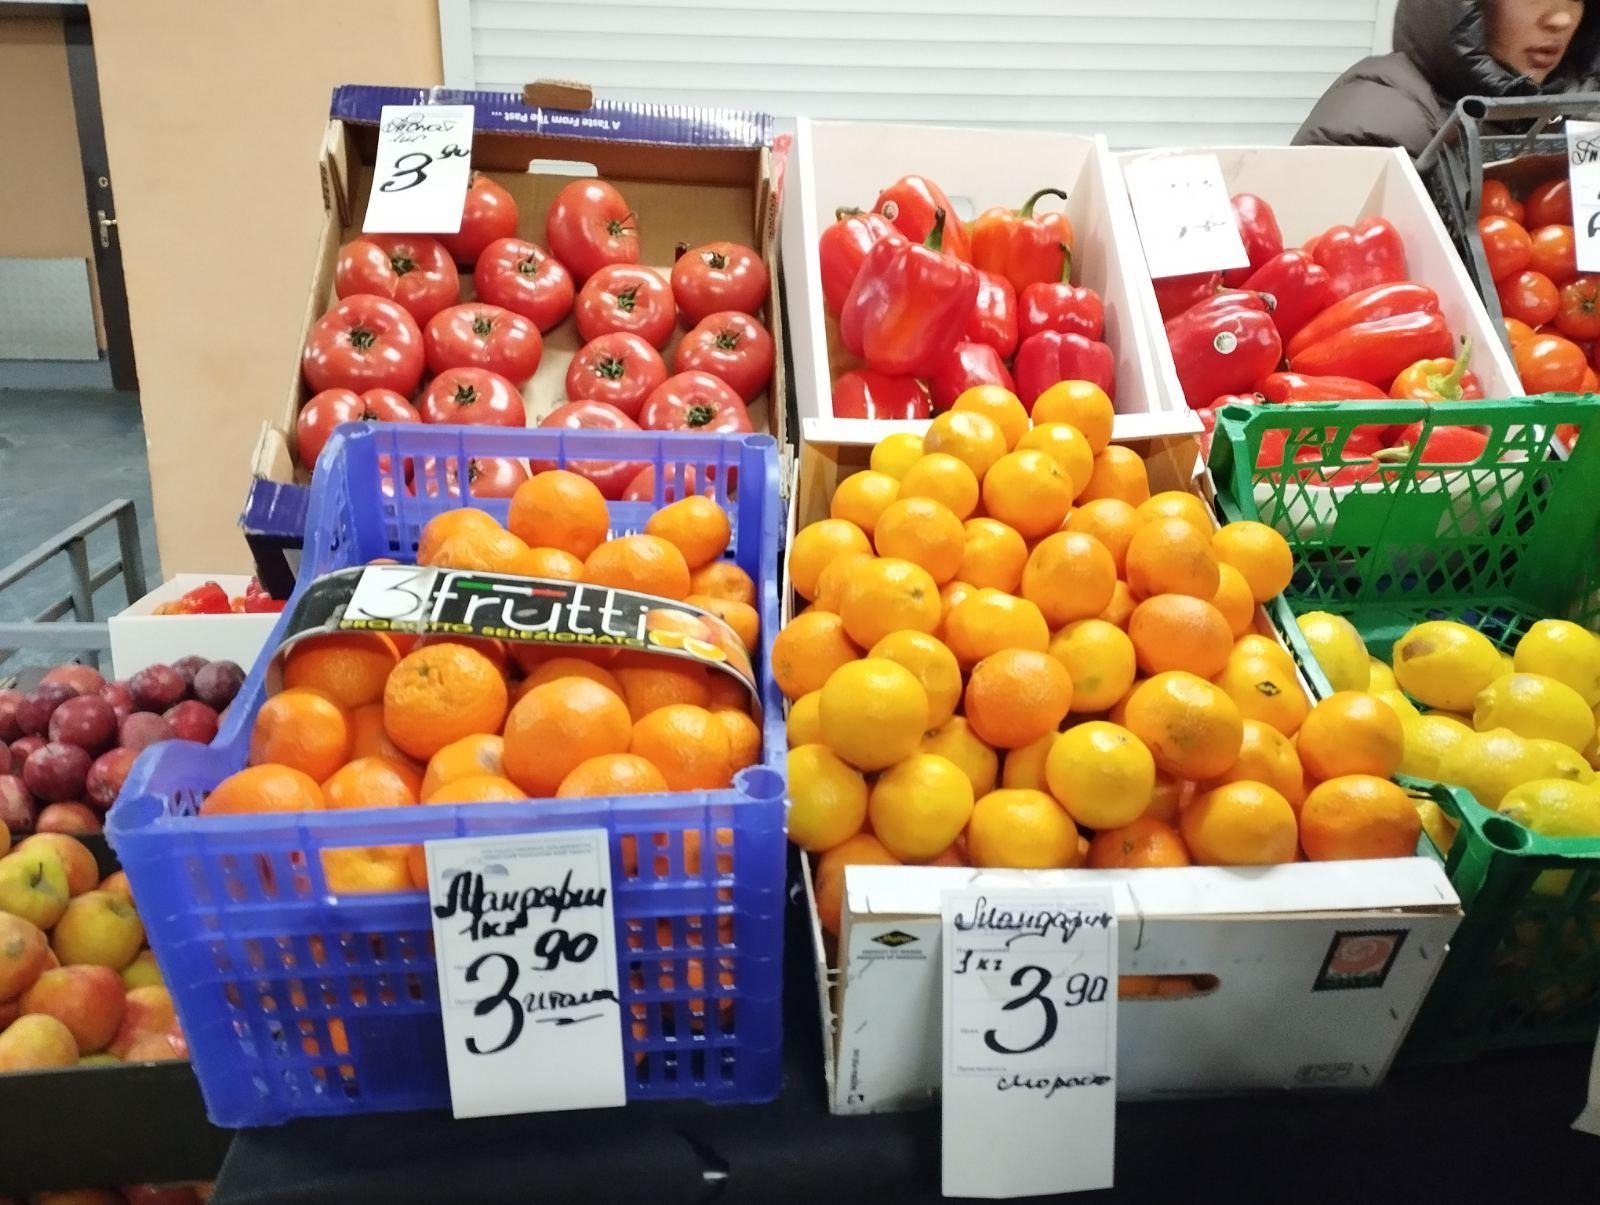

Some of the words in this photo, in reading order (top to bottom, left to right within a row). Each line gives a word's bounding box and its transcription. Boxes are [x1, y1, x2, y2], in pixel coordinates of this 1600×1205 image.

[503, 112, 528, 123] Past
[530, 112, 549, 125] The
[551, 115, 580, 127] From
[581, 118, 610, 130] Taste
[612, 120, 621, 130] A
[380, 152, 432, 193] 3
[465, 953, 524, 1055] 3
[531, 929, 598, 971] 90
[984, 965, 1058, 1054] 3
[1064, 973, 1108, 1007] 90
